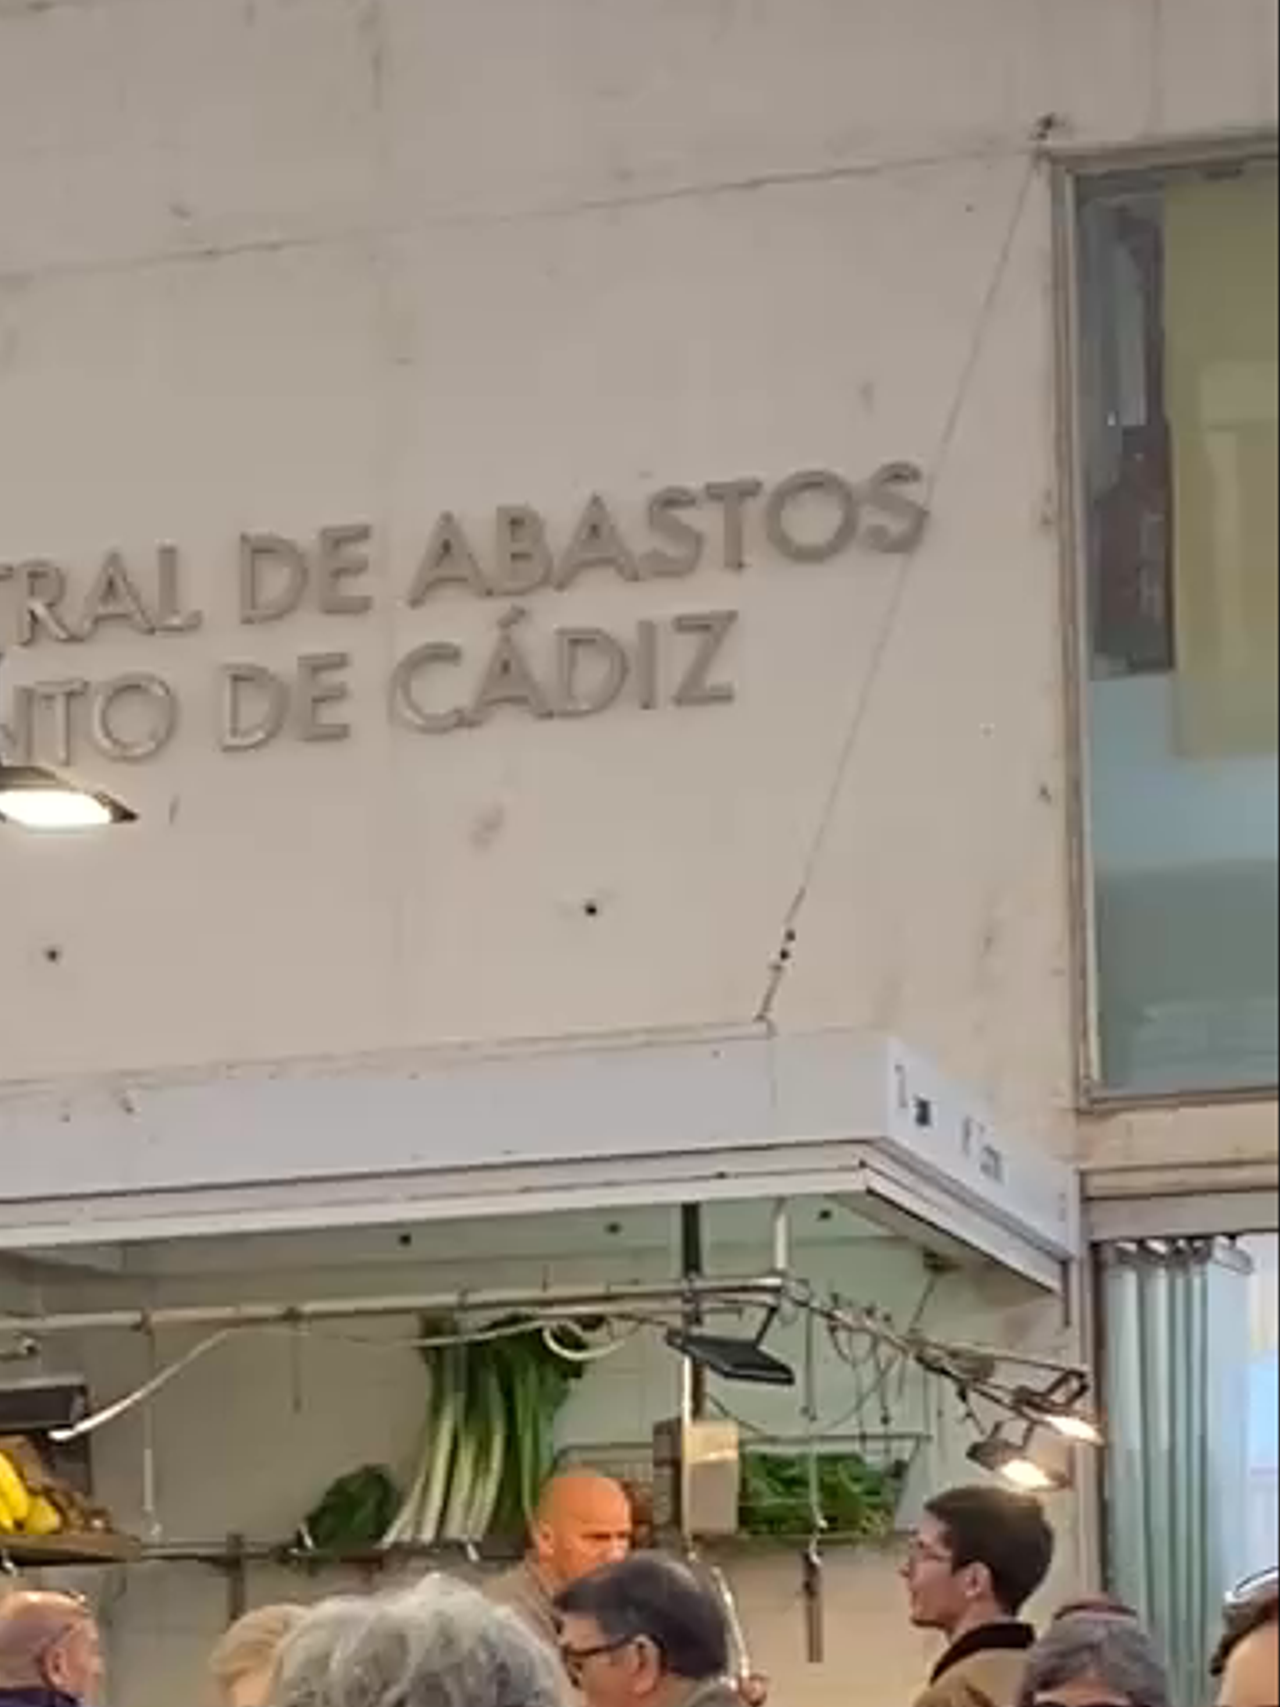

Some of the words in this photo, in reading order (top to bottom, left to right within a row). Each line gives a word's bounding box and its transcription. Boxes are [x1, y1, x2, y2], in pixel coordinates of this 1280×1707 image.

[239, 524, 373, 624] DE
[406, 460, 930, 610] ABASTOS
[220, 650, 352, 753] DE
[387, 604, 740, 735] CÁDIZ
